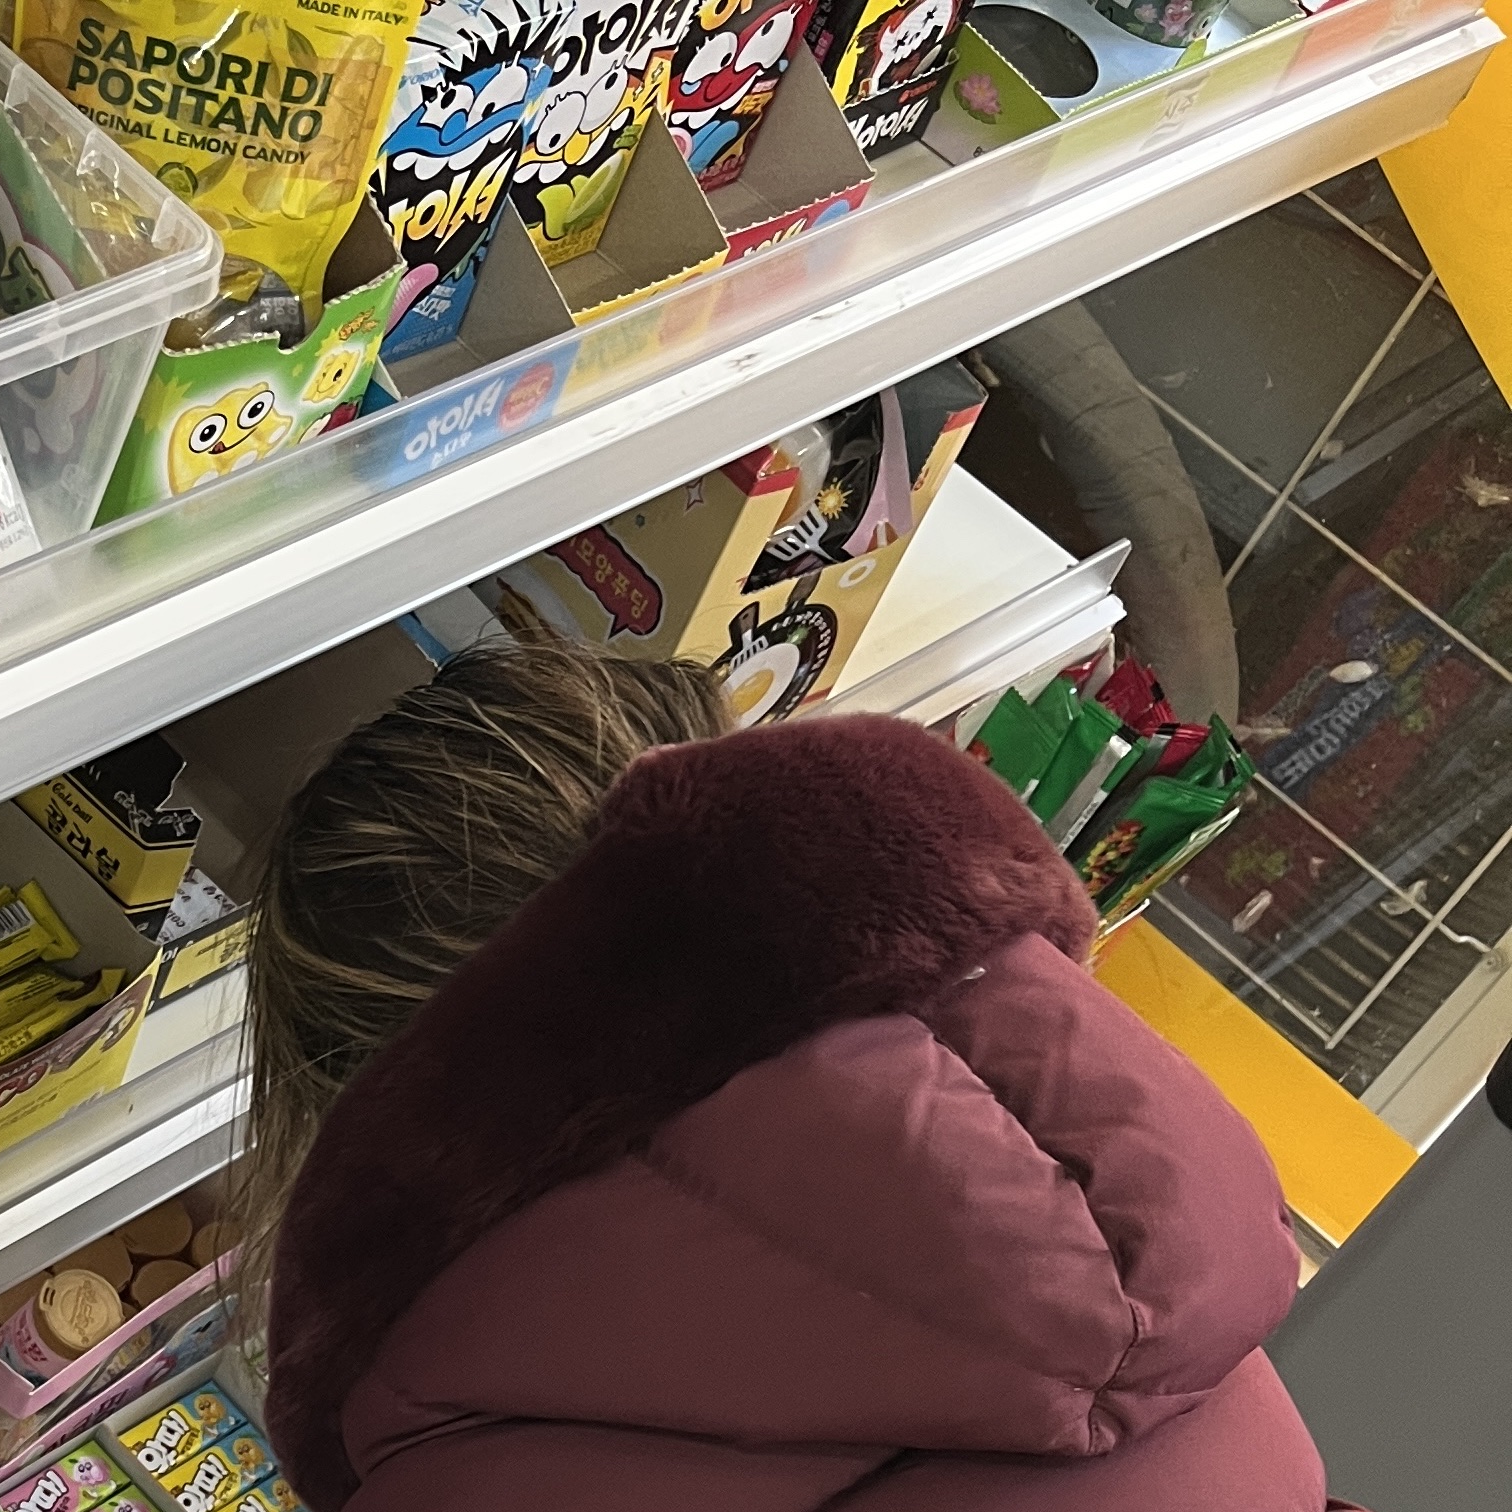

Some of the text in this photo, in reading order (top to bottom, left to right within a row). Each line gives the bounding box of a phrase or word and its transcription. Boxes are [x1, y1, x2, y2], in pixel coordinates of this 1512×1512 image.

[295, 0, 405, 27] MADE IN ITALY
[66, 56, 323, 145] POSITANO
[76, 17, 335, 108] SAPORI DI
[164, 128, 238, 157] LEMON
[242, 143, 312, 166] CANDY
[570, 540, 649, 620] 모양푸딩
